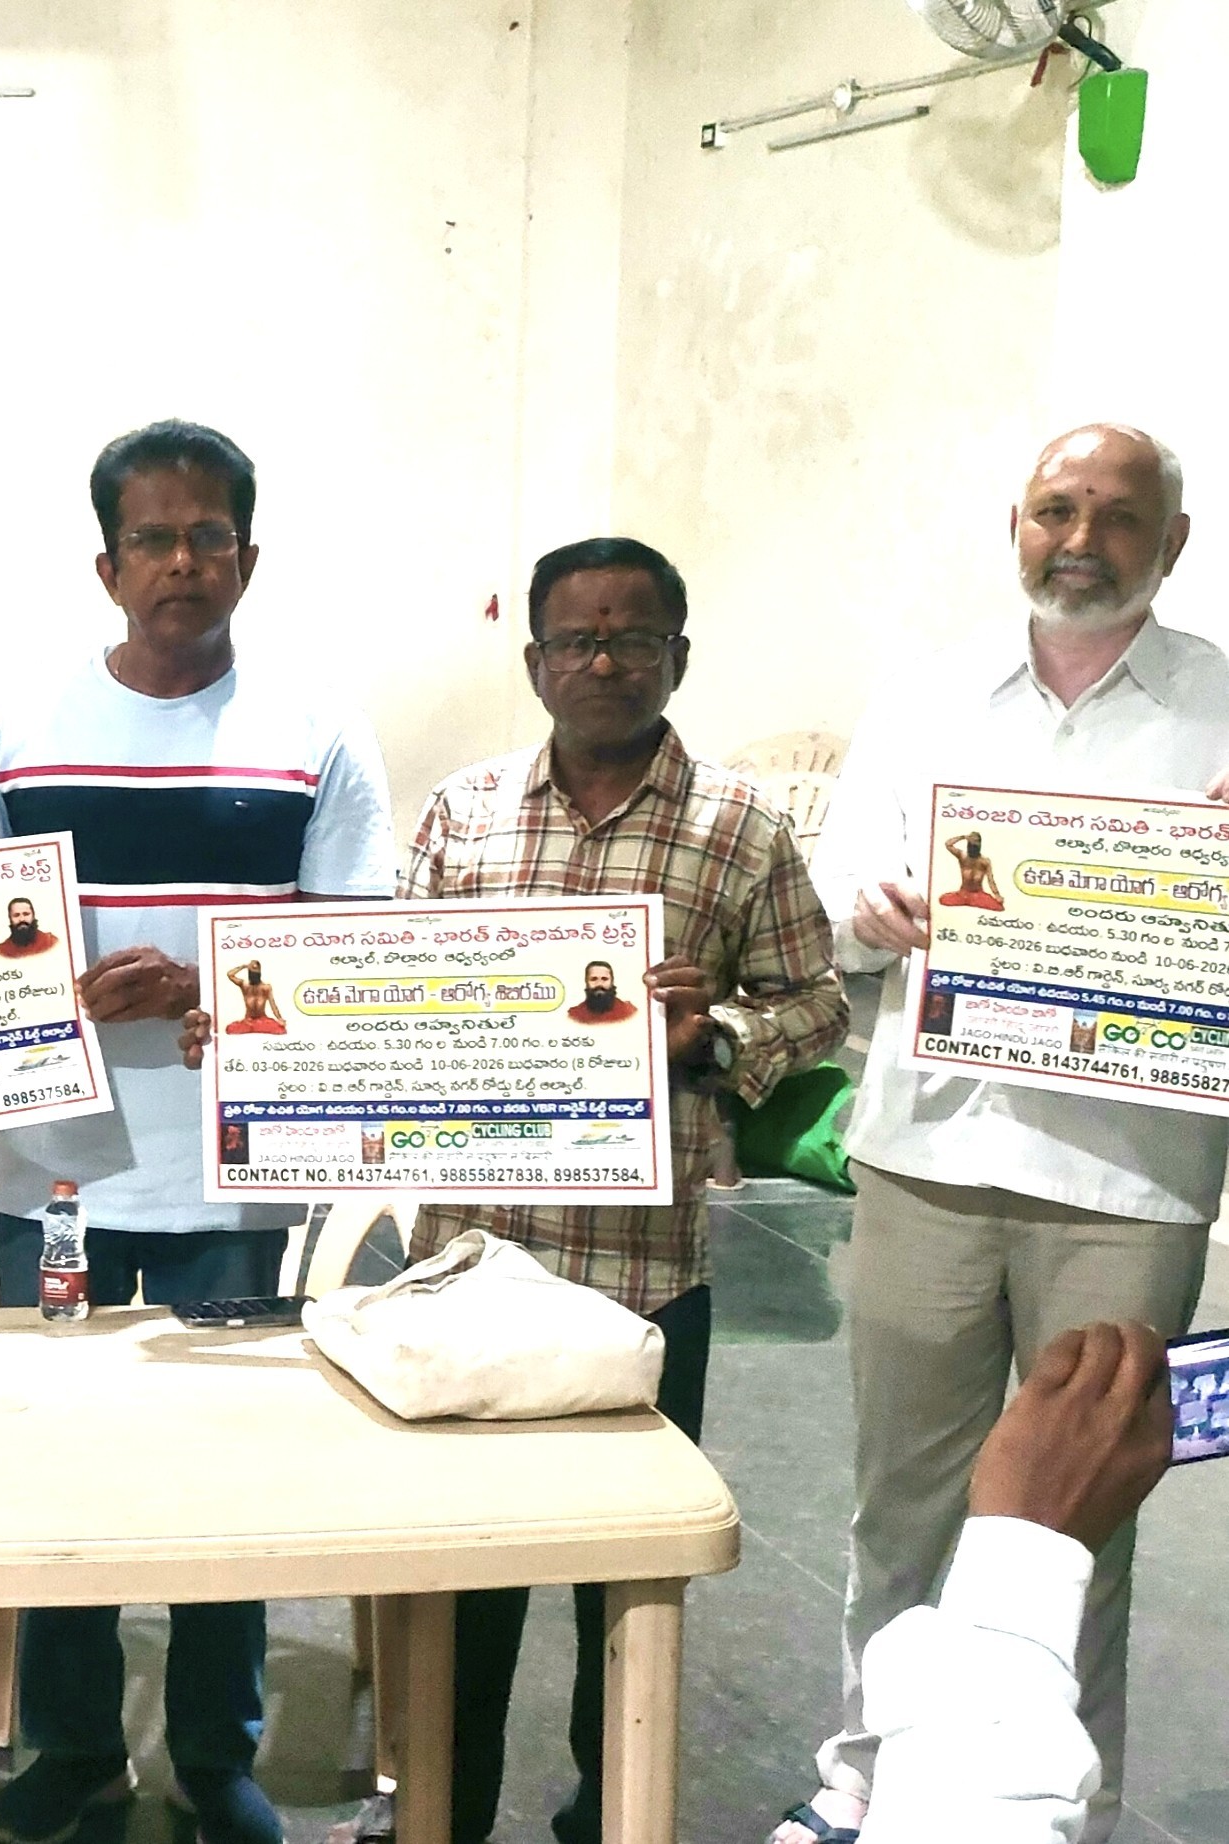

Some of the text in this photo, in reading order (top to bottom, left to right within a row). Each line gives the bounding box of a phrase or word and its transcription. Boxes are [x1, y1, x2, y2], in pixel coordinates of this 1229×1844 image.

[941, 803, 1022, 823] పతంజలి
[1027, 810, 1084, 828] యోగ
[1090, 815, 1149, 834] సమితి
[19, 858, 51, 882] ట్రస్ట్
[220, 922, 636, 949] పతంజలి యోగ సమితి భారత్ స్వాభిమాన్ ట్రస్ట్
[924, 1036, 1003, 1060] CONTACT
[1007, 1047, 1035, 1065] NO.
[1041, 1052, 1143, 1083] 8143744761,
[2, 1082, 85, 1106] 898537584,
[472, 1123, 551, 1138] CYCLING CLUB
[227, 1167, 644, 1184] CONTACT NO. 8143744761, 98855827838, 898537584,
